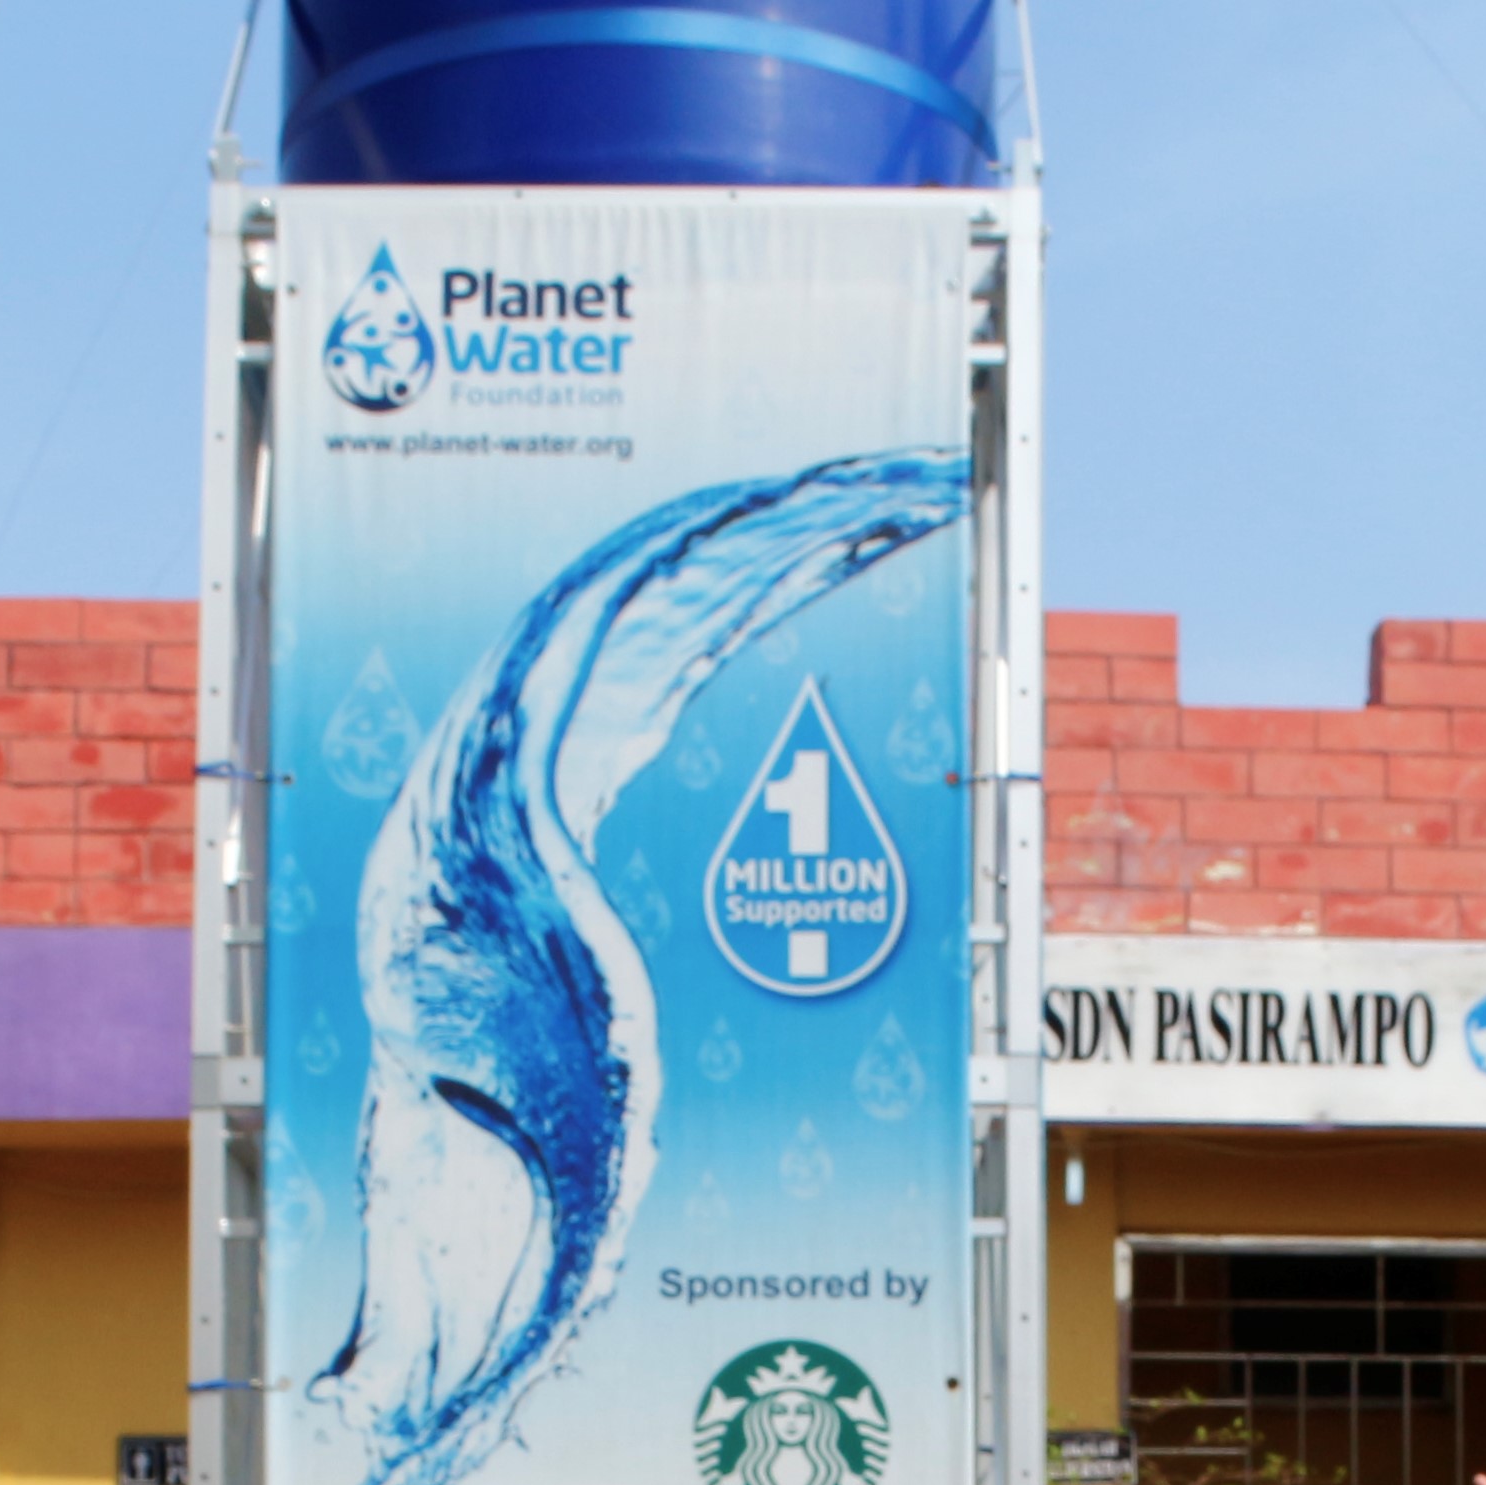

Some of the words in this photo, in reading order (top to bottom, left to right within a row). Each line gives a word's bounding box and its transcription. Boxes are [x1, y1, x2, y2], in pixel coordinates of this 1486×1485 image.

[443, 269, 632, 319] Planet
[443, 325, 632, 374] Water
[450, 383, 624, 406] Foundation
[325, 433, 633, 461] www.planet-water.org
[725, 859, 886, 892] MILLION
[726, 895, 886, 927] Supported
[1043, 985, 1137, 1063] SDN
[1153, 988, 1434, 1068] PASIRAMPO
[659, 1268, 871, 1304] Sponsored
[885, 1268, 929, 1306] by
